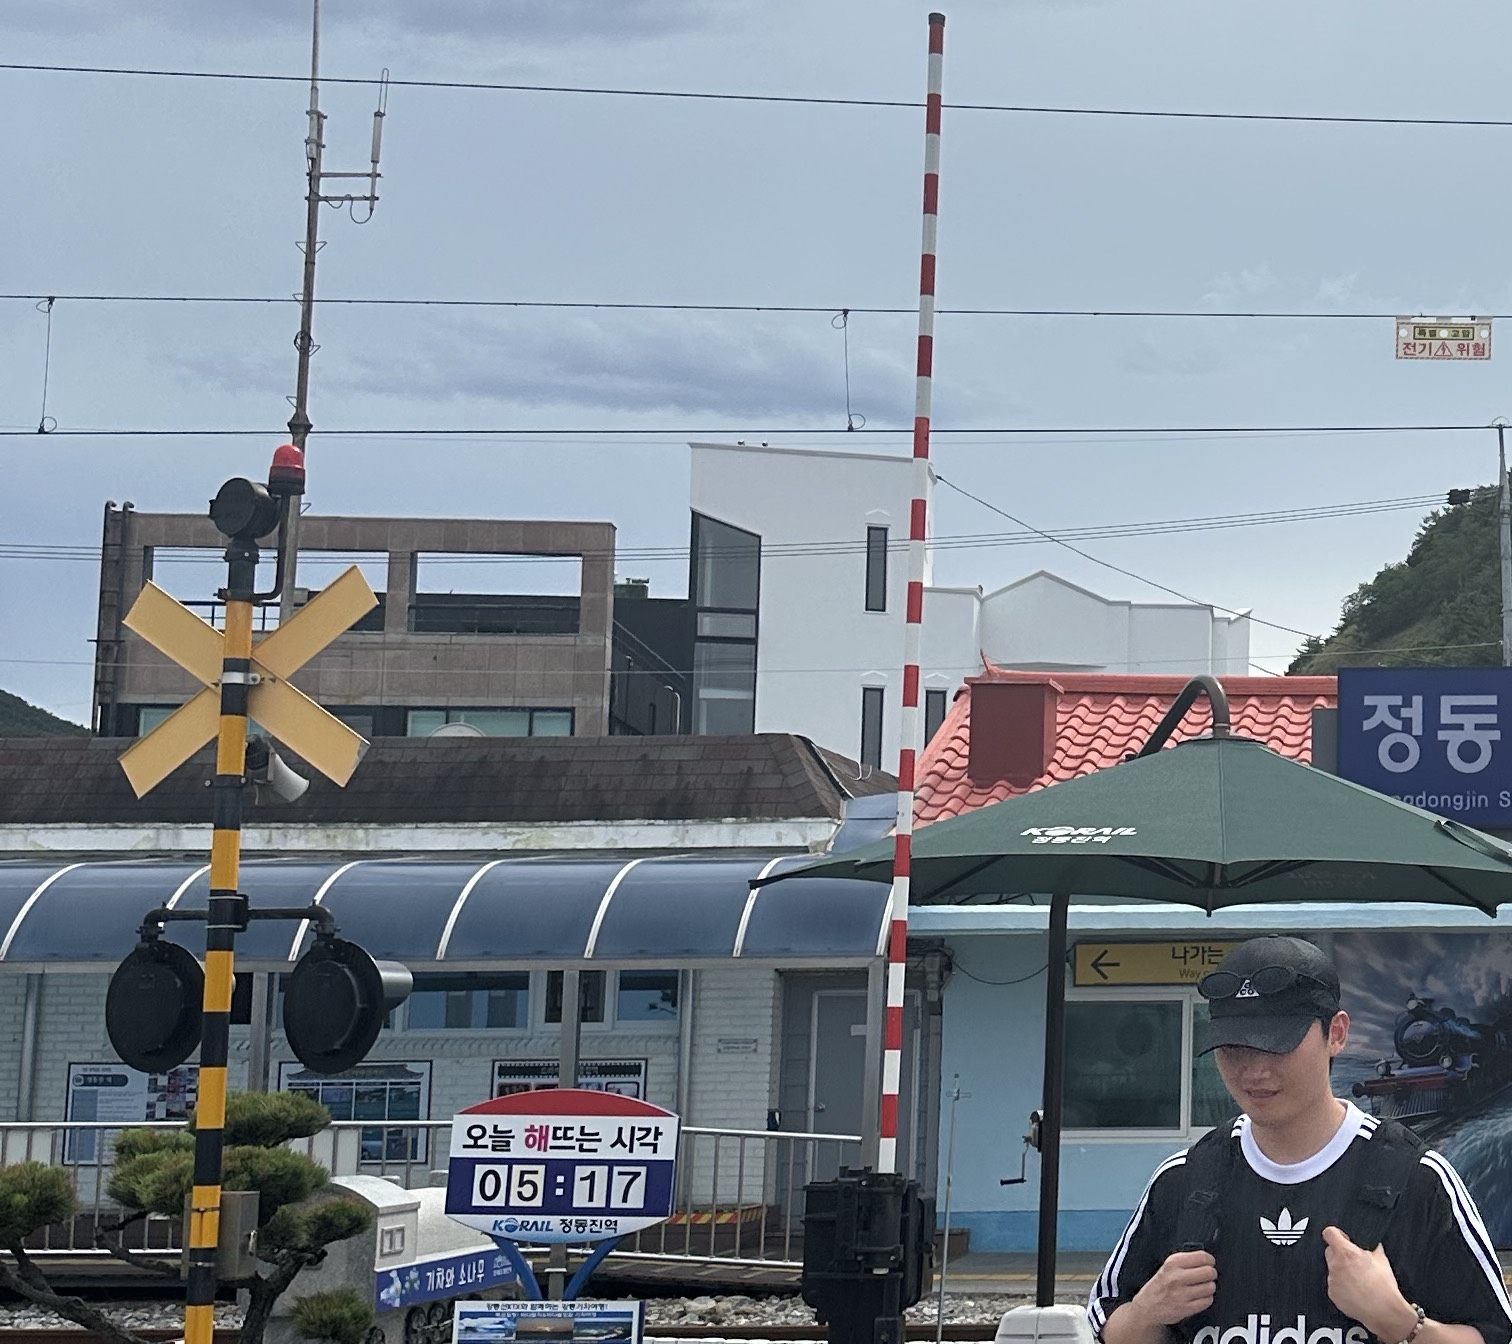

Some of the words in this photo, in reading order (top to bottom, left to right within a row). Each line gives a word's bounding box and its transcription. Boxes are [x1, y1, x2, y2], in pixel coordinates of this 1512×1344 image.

[1403, 342, 1432, 356] 전기
[1456, 342, 1485, 356] 위험
[1020, 826, 1137, 836] KORAIL
[1171, 946, 1223, 965] 나가는
[1179, 968, 1201, 981] Way
[462, 1124, 515, 1152] 오늘
[524, 1124, 602, 1153] 해뜨는
[610, 1126, 663, 1154] 시각
[492, 1217, 553, 1233] KORAIL
[559, 1218, 618, 1234] 정동진역
[426, 1267, 455, 1292] 기차와
[458, 1259, 485, 1286] 소나무
